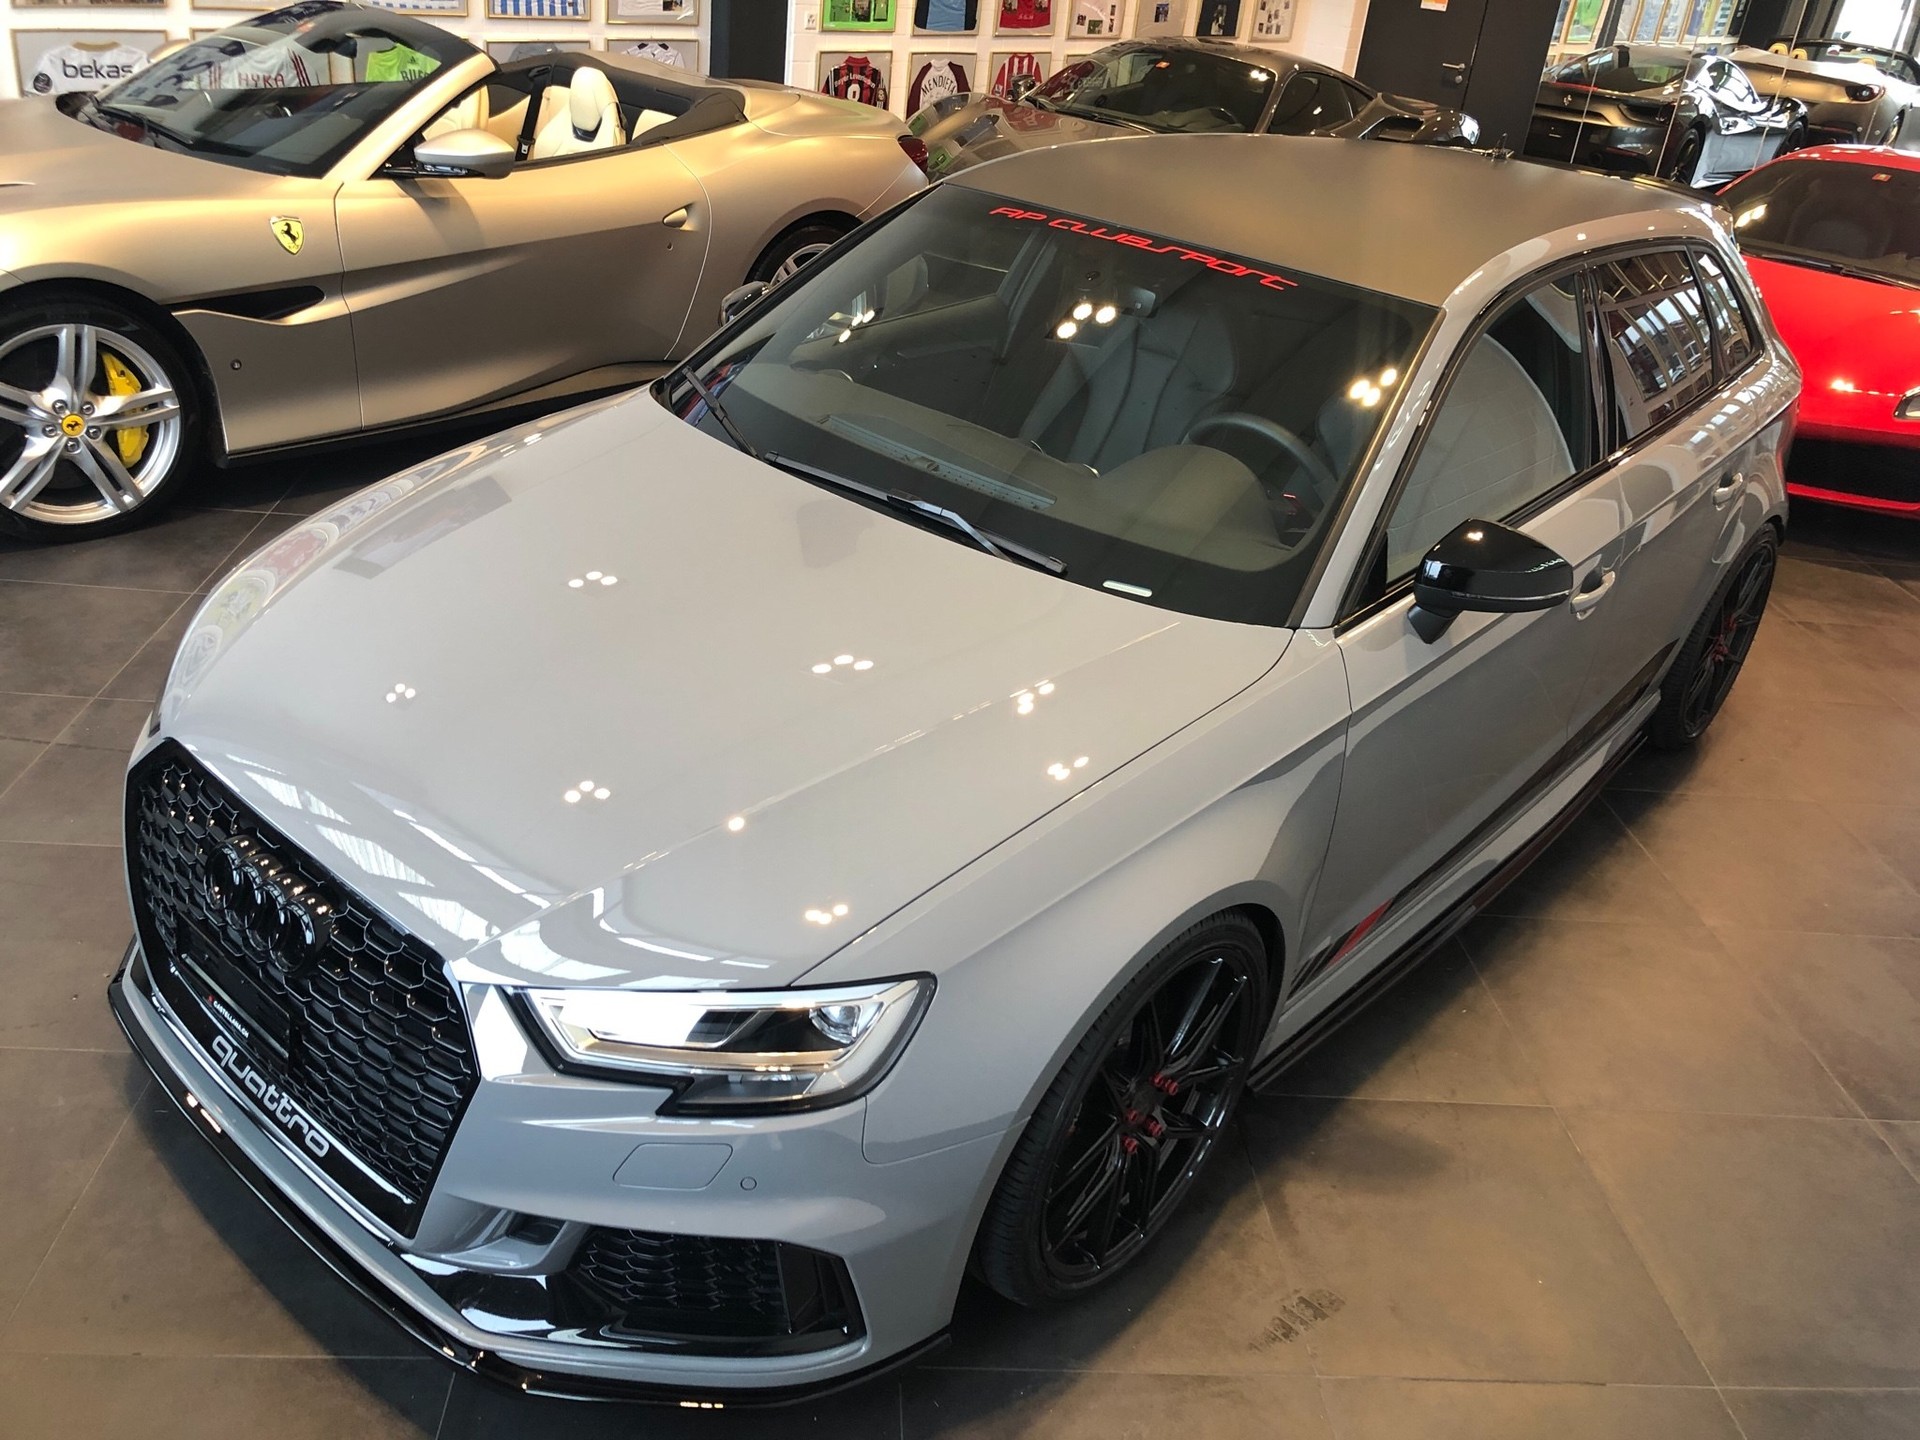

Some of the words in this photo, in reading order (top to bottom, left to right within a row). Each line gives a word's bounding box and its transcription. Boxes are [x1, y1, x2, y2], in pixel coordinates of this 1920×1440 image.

[62, 59, 133, 78] bekas
[921, 75, 957, 97] MENDIETA
[989, 206, 1048, 221] AP
[212, 1035, 330, 1158] quattro
